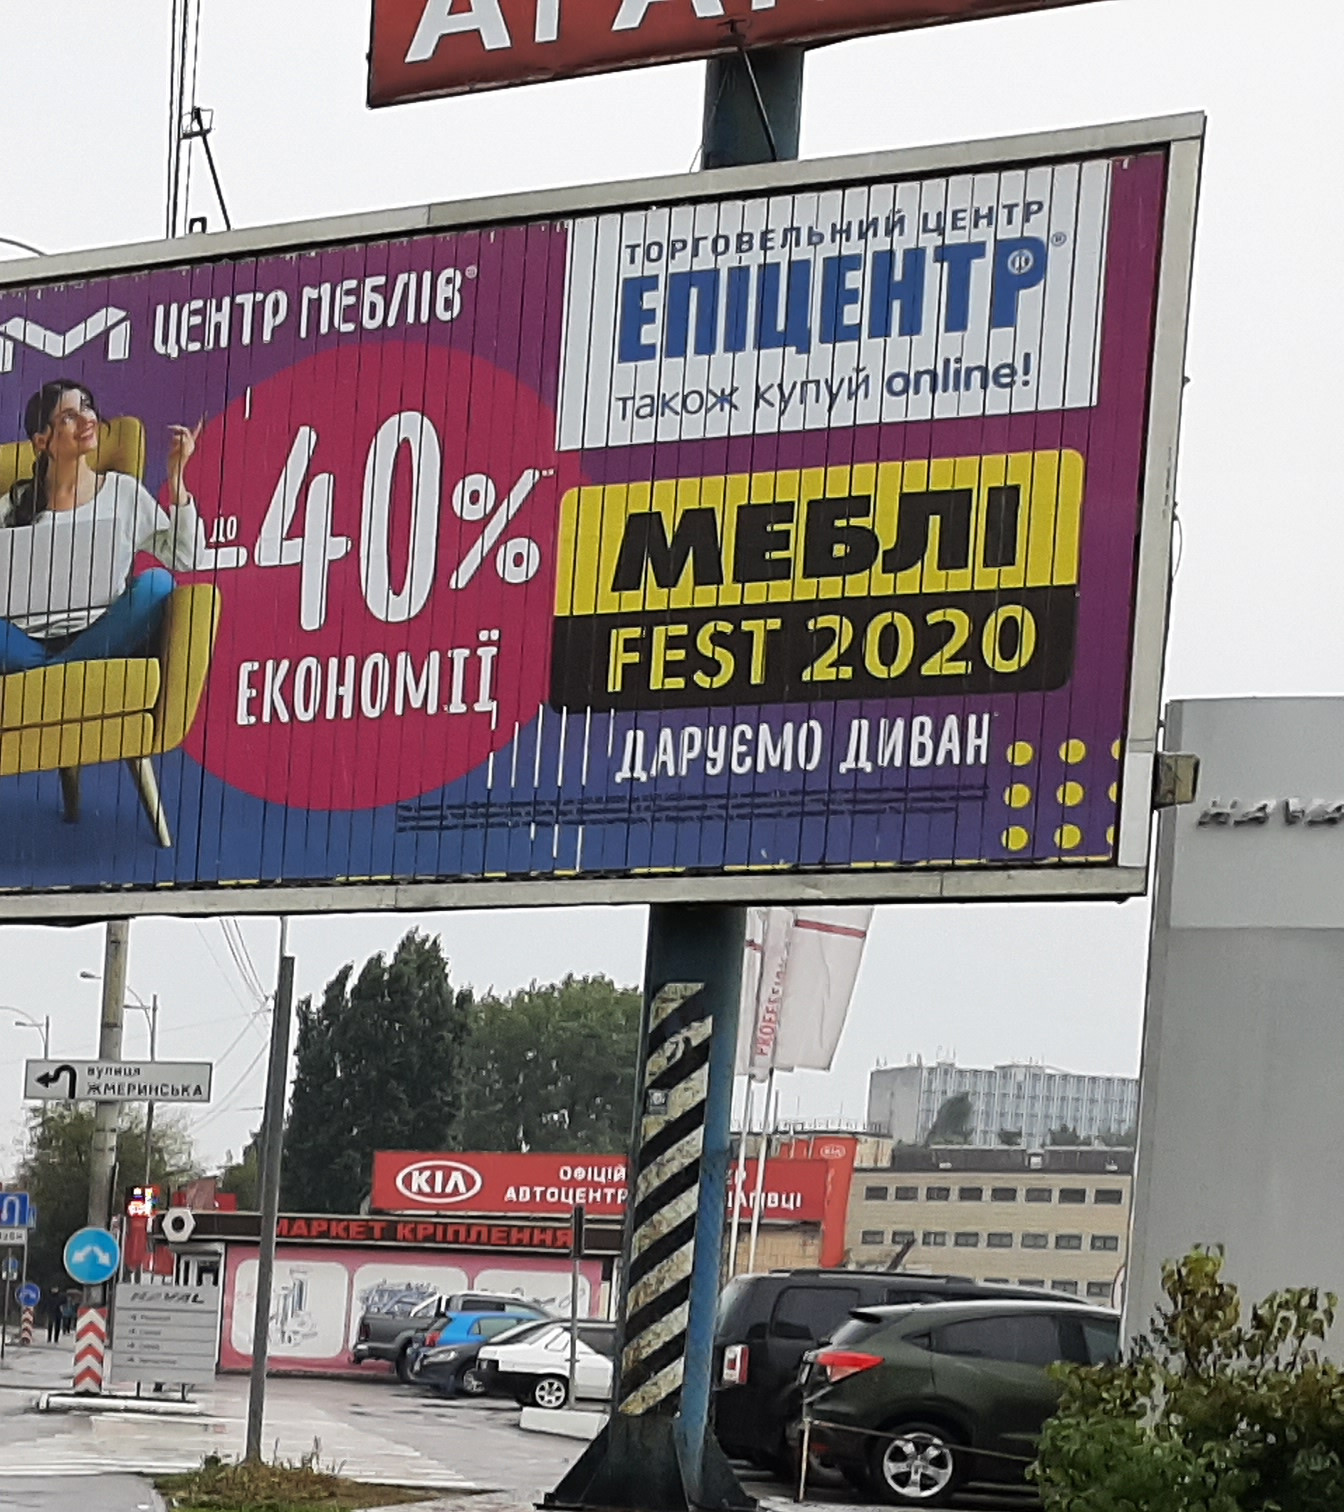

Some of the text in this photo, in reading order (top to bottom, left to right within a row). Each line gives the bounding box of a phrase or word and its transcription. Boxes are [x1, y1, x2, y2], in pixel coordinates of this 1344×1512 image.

[625, 200, 1045, 266] ТОРГОВЕЛЬНИЙ ЦЕНТР
[152, 288, 288, 359] ЦЕНТР
[300, 267, 463, 340] МЕБЛІВ
[616, 236, 1048, 364] ЕПІЦЕНТР
[615, 352, 1033, 423] також купуй online!
[610, 483, 1023, 593] МЕБЛІ
[235, 627, 502, 726] ЕКОНОМІЇ
[606, 604, 1037, 693] FEST 2020
[614, 712, 992, 783] ДАРУЄМО ДИВАН
[86, 1066, 141, 1080] вулиця
[86, 1081, 204, 1097] ЖМЕРИНСЬКА
[412, 1170, 467, 1194] KIA
[558, 1163, 628, 1184] ОФІЦІЙ
[397, 1221, 573, 1248] КРІПЛЕННЯ
